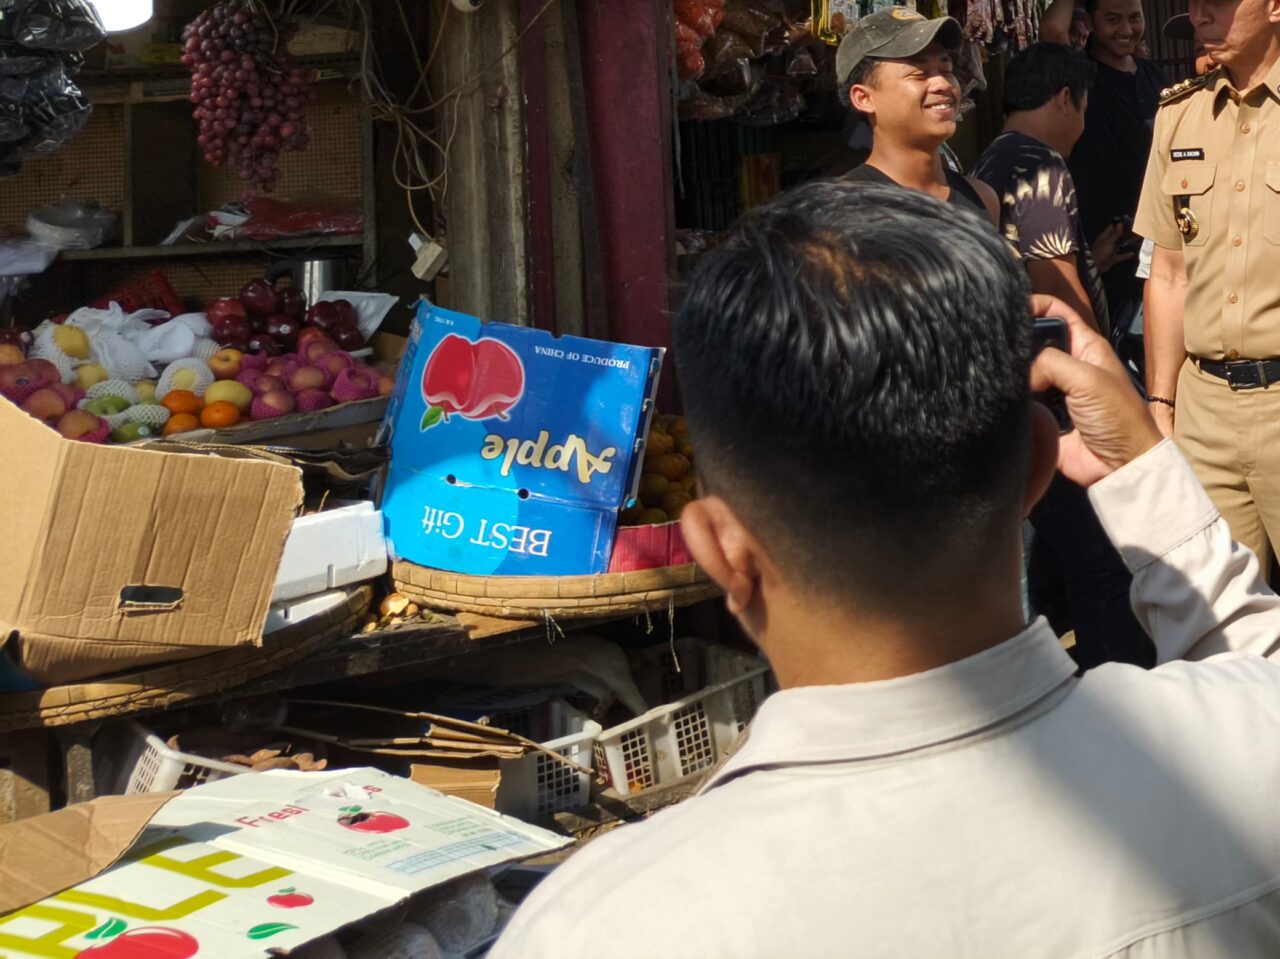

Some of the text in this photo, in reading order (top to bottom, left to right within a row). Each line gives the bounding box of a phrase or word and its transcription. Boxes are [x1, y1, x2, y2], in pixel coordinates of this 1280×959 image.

[534, 345, 630, 370] PRODUCE OF CHINA
[480, 429, 616, 484] Apple
[421, 505, 552, 557] BEST Gift
